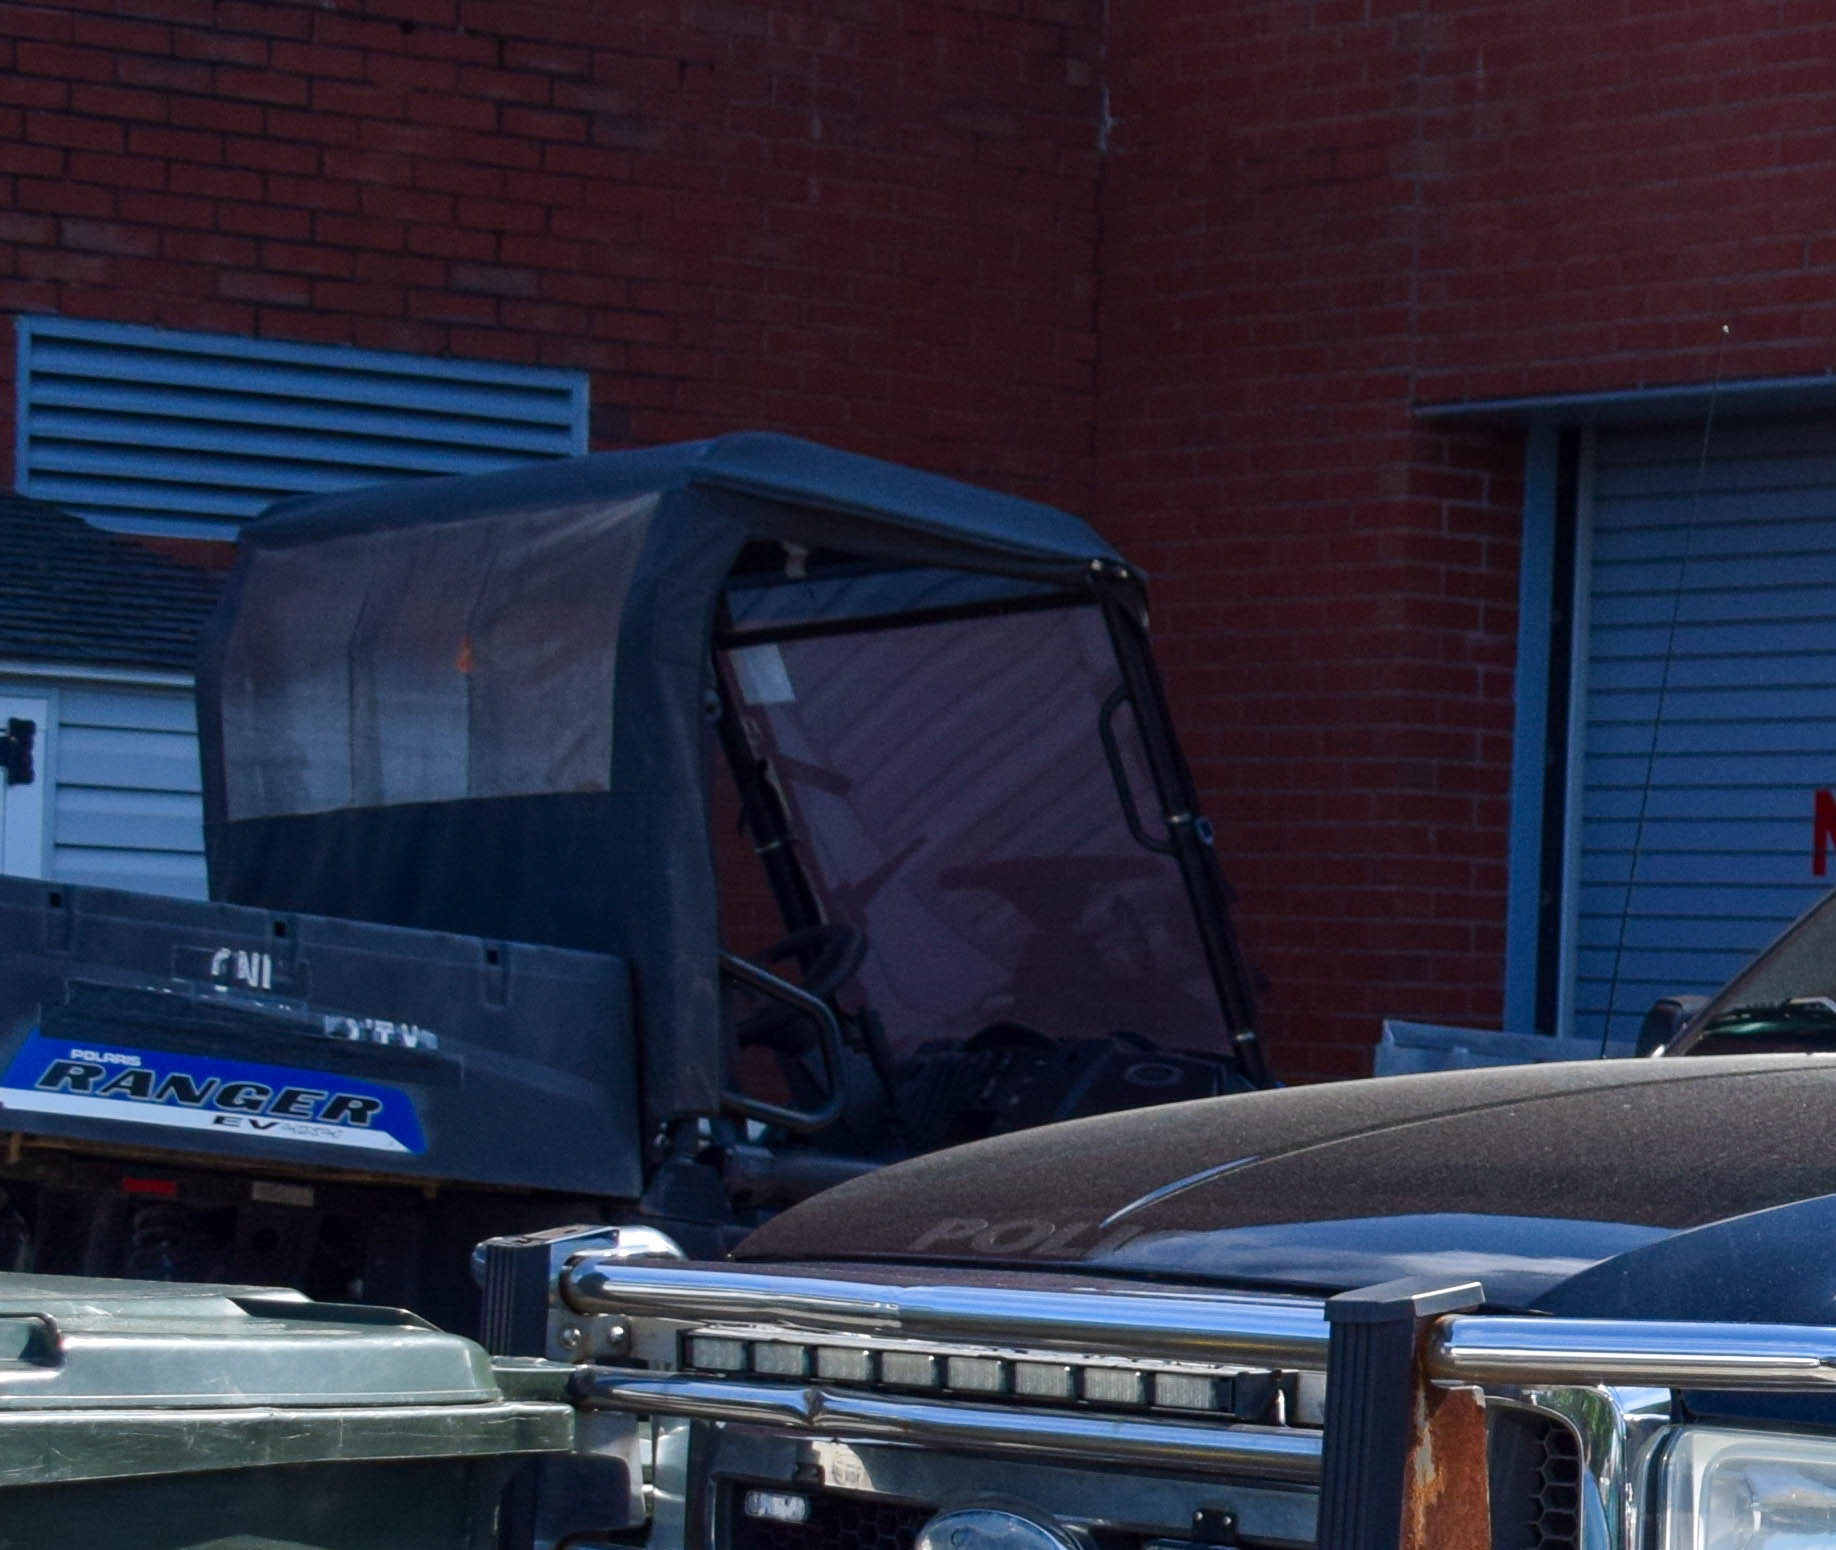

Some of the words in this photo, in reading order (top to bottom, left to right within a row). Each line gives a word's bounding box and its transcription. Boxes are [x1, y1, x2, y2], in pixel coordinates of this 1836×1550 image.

[69, 1048, 142, 1067] POLARIS
[35, 1058, 382, 1126] RANGER
[212, 1114, 280, 1131] EV
